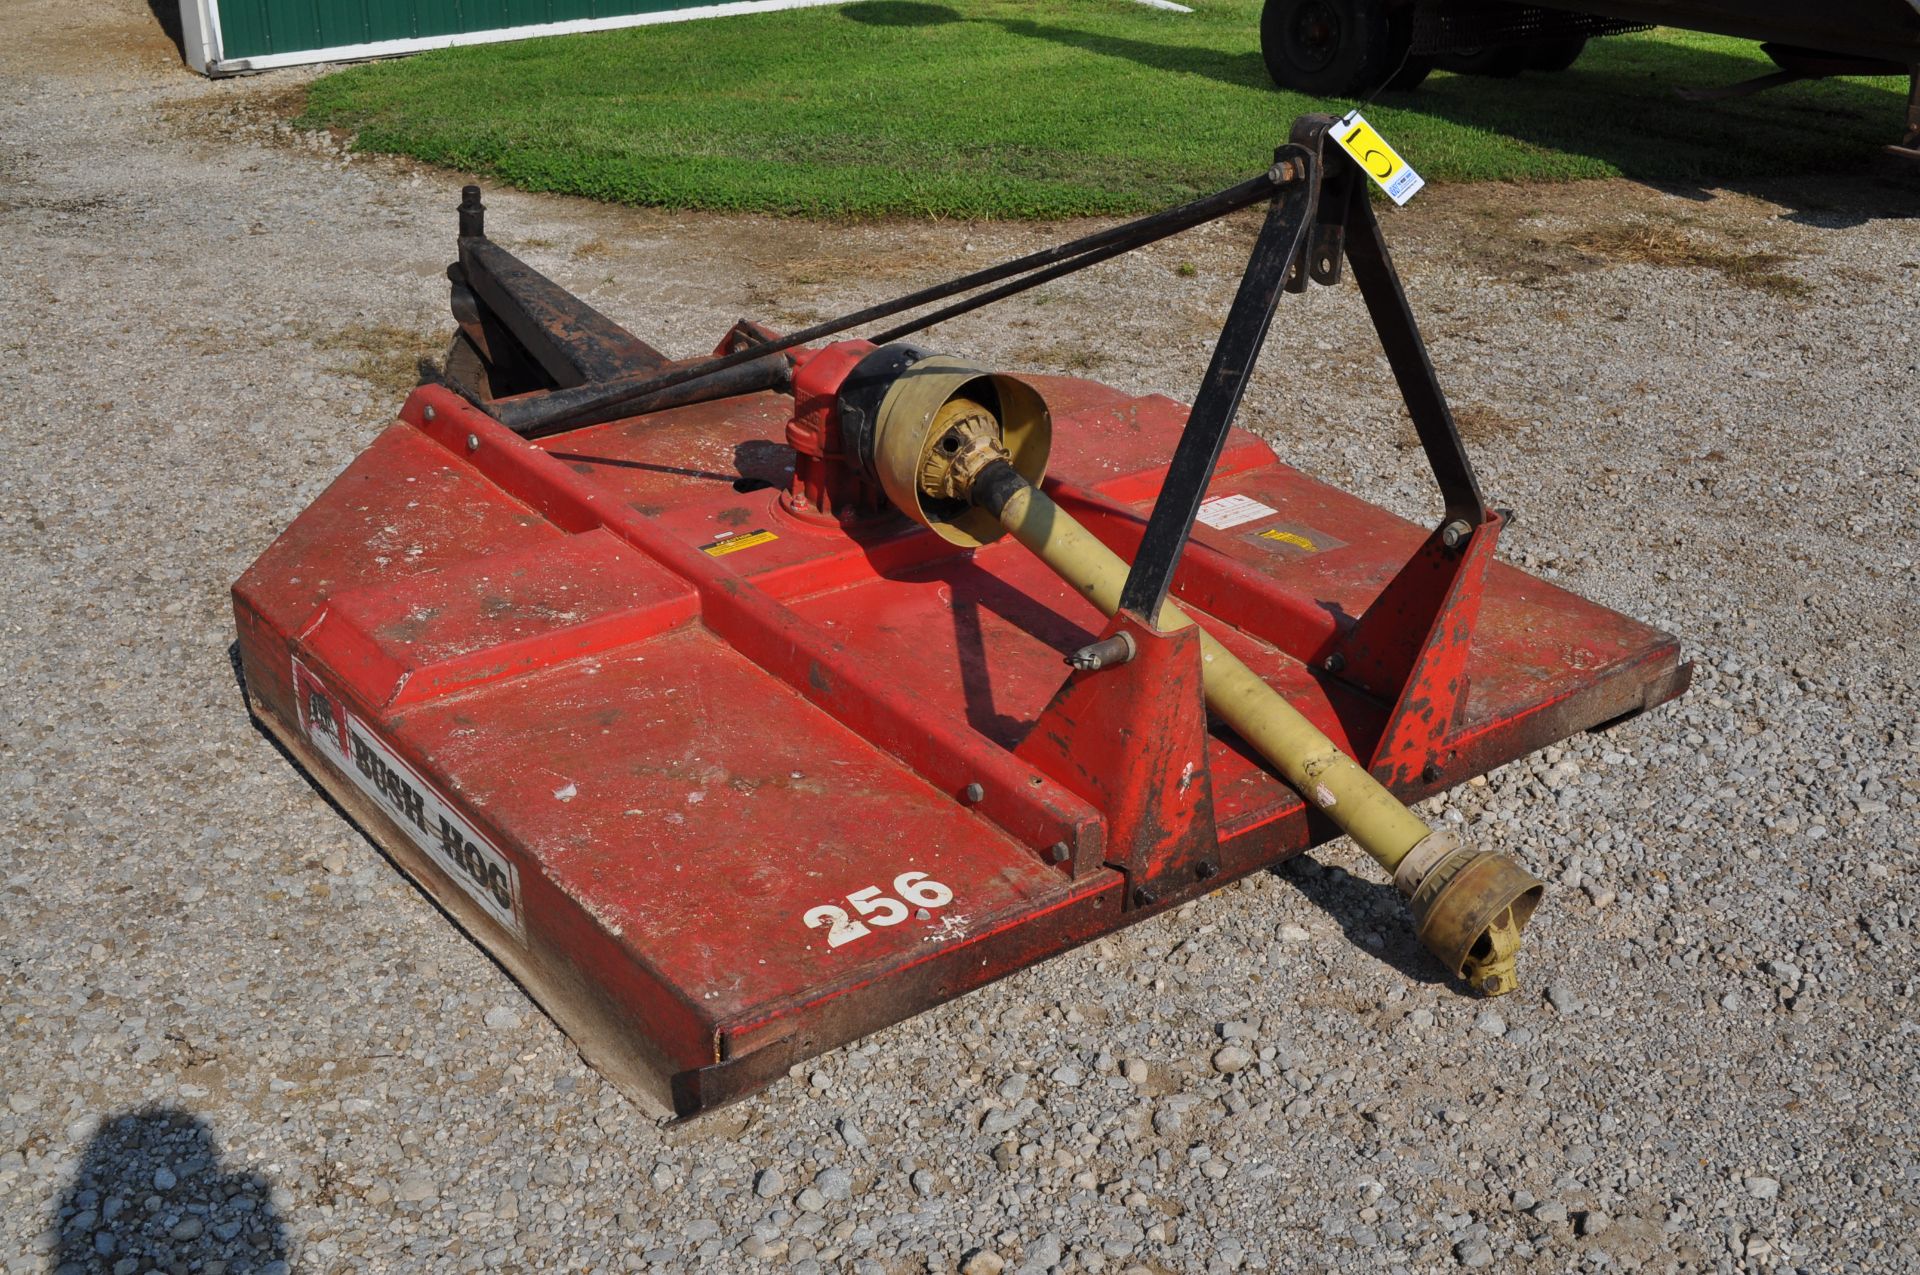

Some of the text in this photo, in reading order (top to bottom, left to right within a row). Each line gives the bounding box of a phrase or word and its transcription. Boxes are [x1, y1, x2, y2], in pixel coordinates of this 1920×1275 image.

[1345, 127, 1392, 178] 5
[350, 732, 511, 910] BUSH HOG
[803, 871, 954, 948] 256
